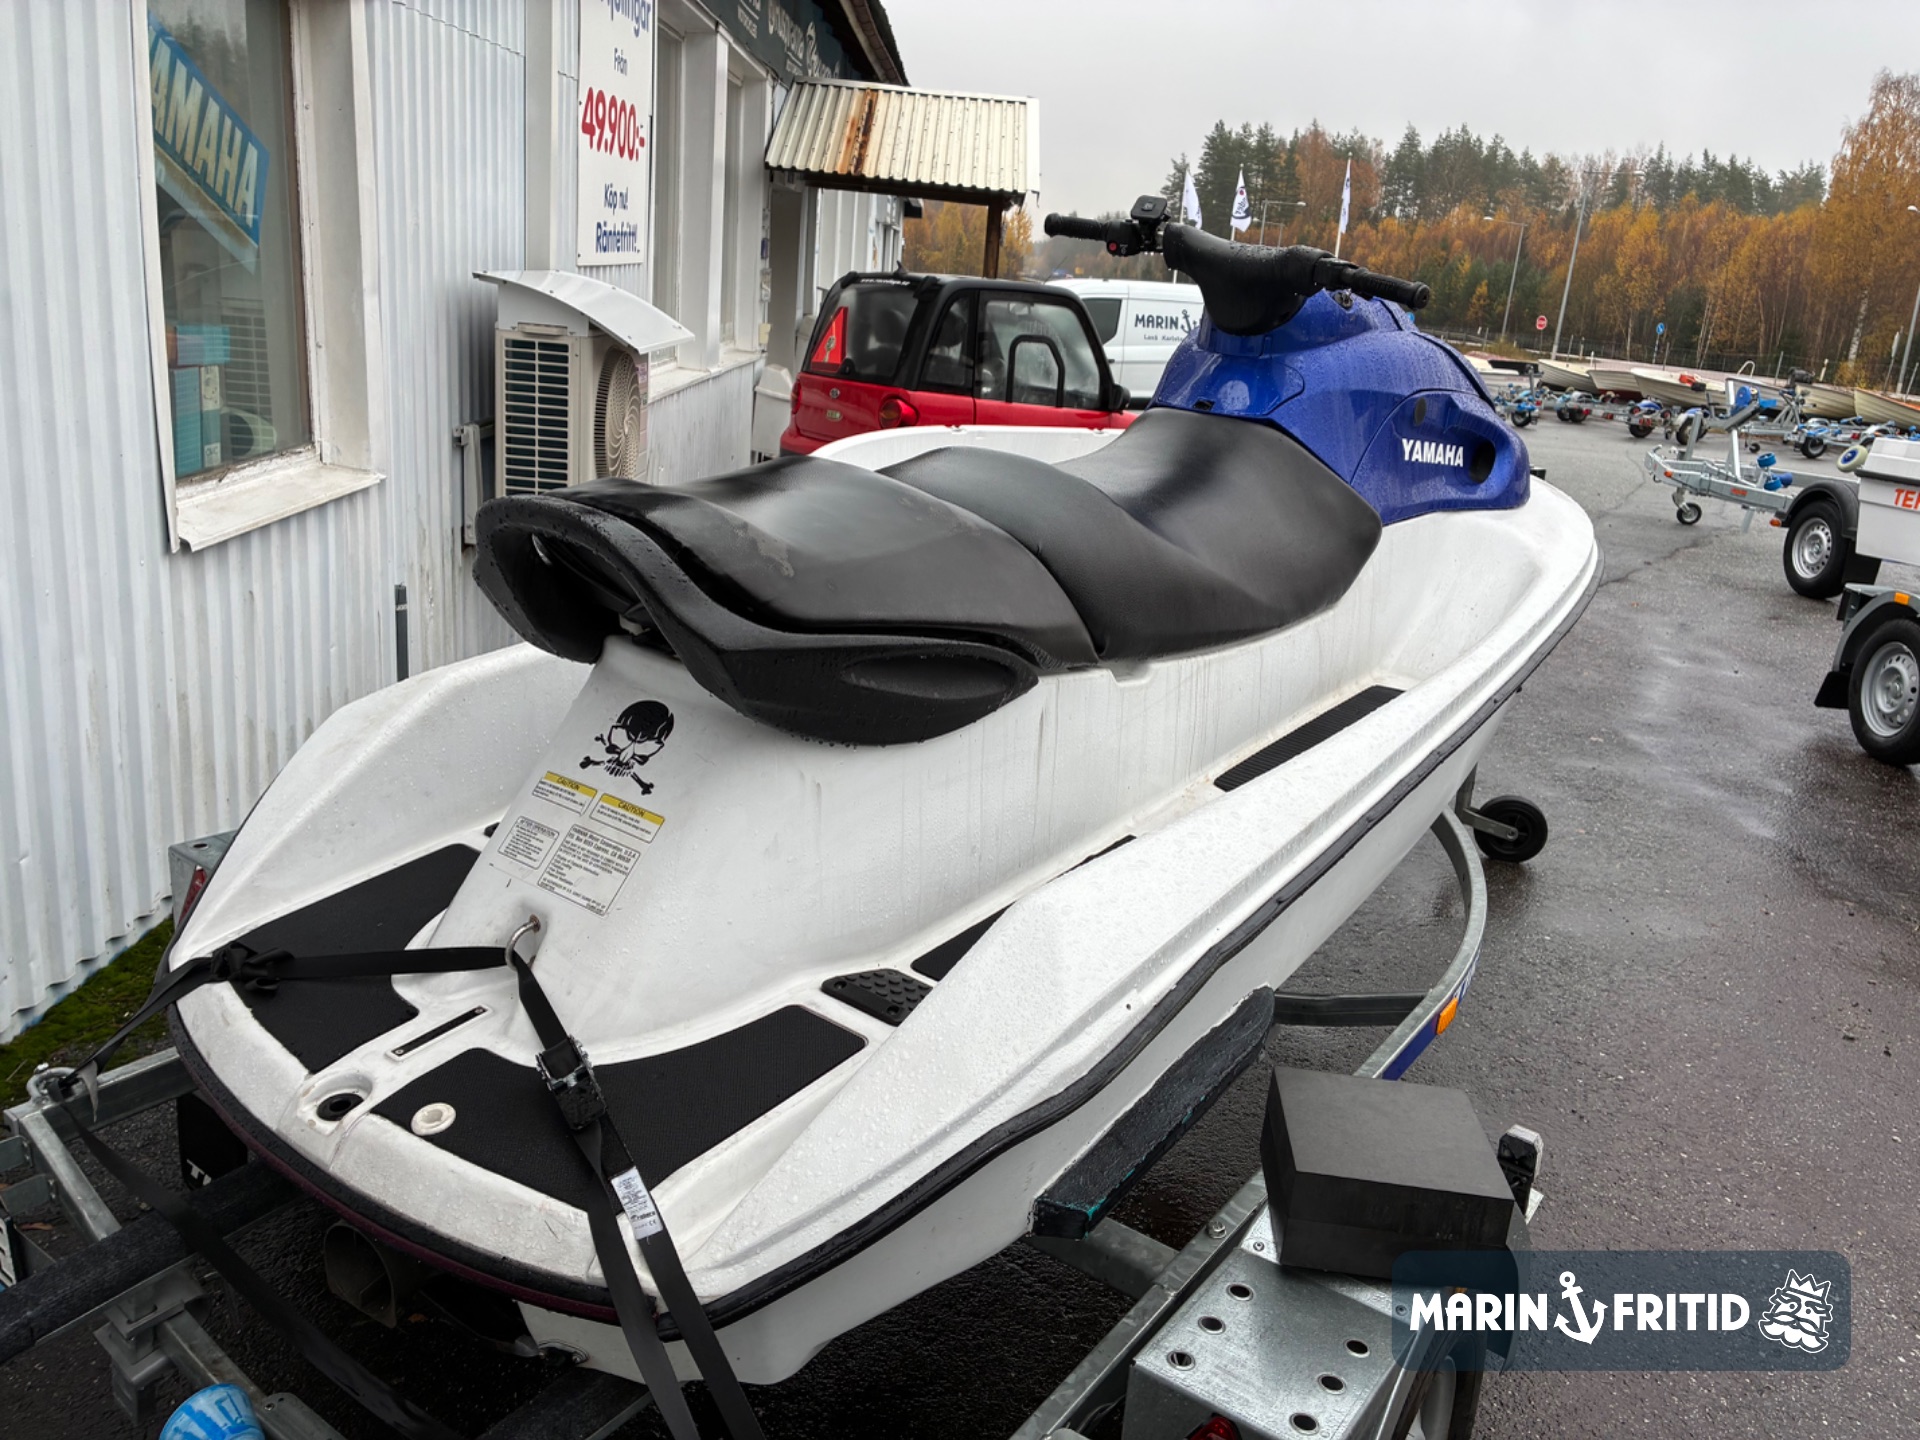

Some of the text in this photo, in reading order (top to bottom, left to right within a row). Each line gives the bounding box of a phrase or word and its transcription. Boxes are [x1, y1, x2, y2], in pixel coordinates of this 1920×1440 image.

[614, 47, 628, 76] Från
[149, 25, 258, 229] AMAHA
[581, 86, 645, 162] 49.900:-
[603, 183, 618, 216] Köp
[596, 221, 638, 253] Räntefritt!
[1134, 313, 1179, 330] MARIN
[1402, 438, 1464, 467] YAMAHA
[557, 776, 580, 791] CAUTION
[617, 801, 645, 817] CAUTION
